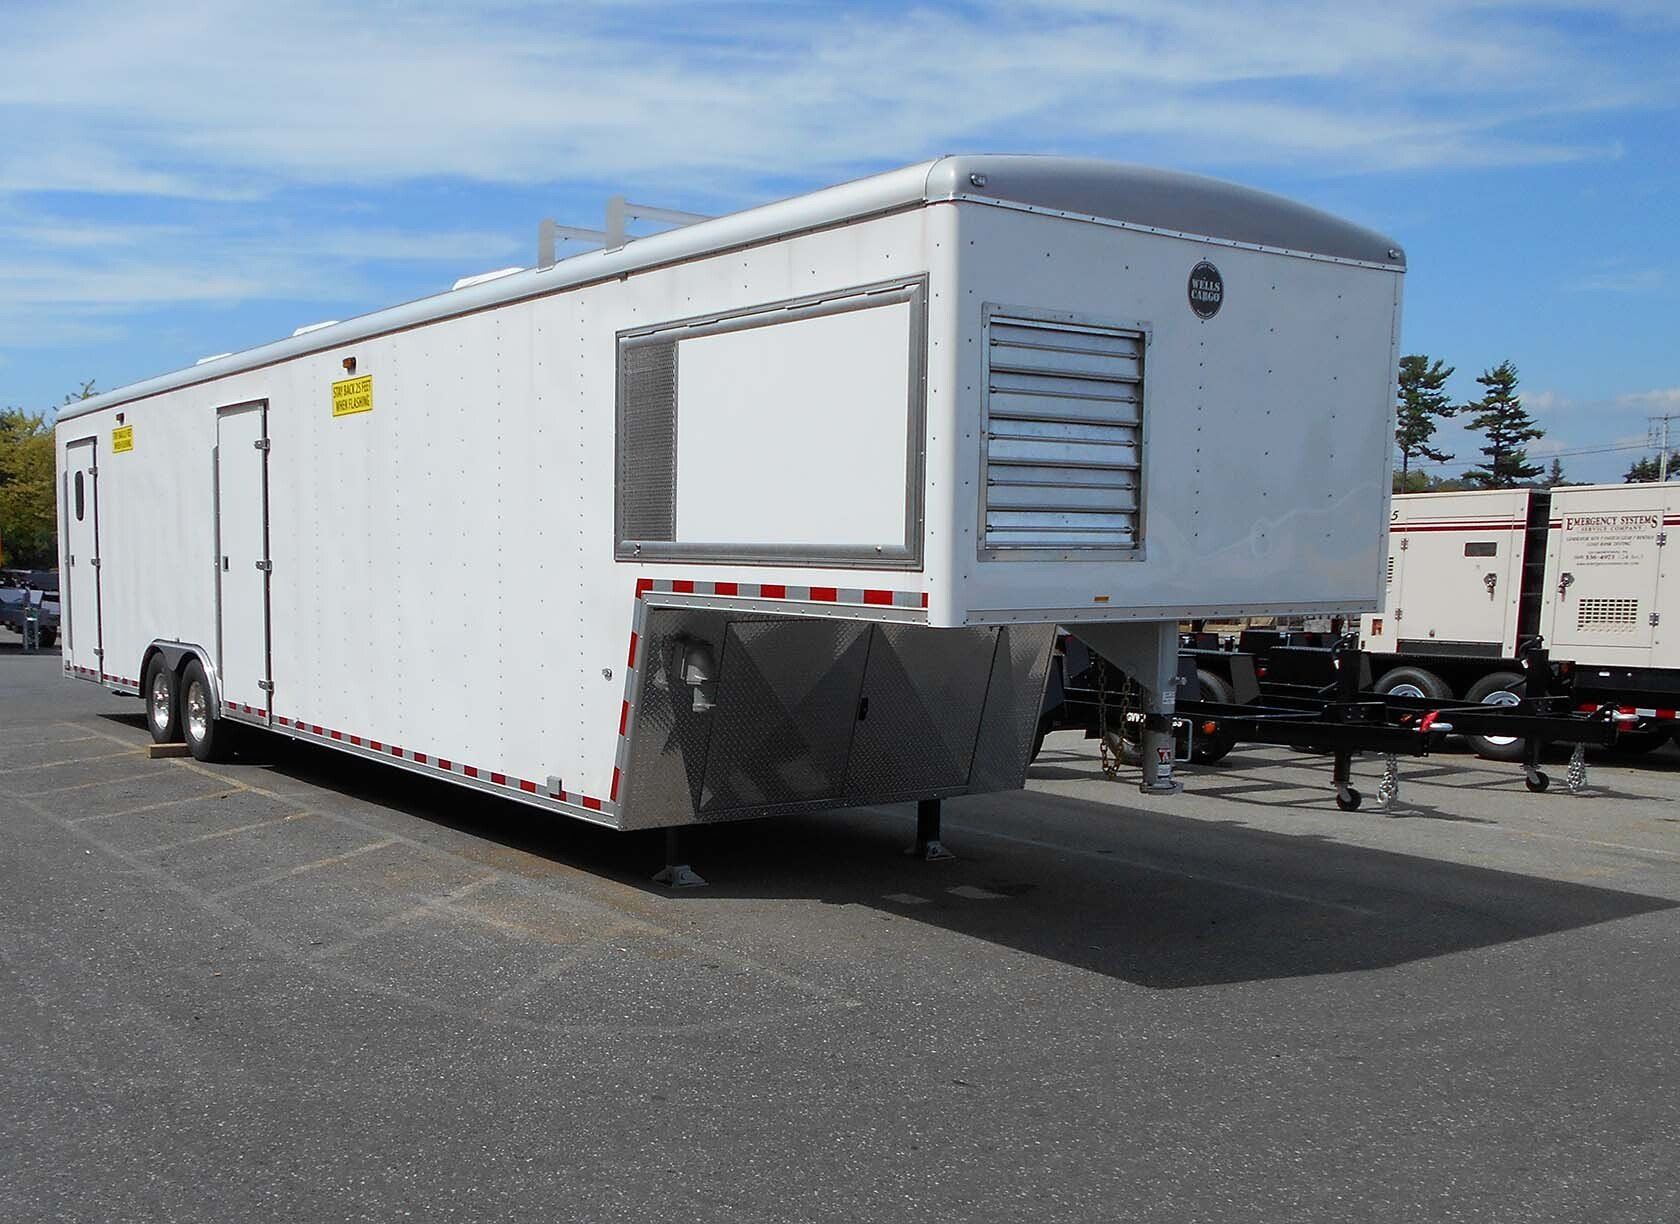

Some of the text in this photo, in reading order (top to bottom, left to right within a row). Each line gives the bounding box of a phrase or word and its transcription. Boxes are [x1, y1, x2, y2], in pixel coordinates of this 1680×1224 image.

[1192, 278, 1220, 291] WELLS
[1191, 290, 1220, 302] CARGO
[1566, 515, 1658, 530] EMERGENCY SYSTEMS
